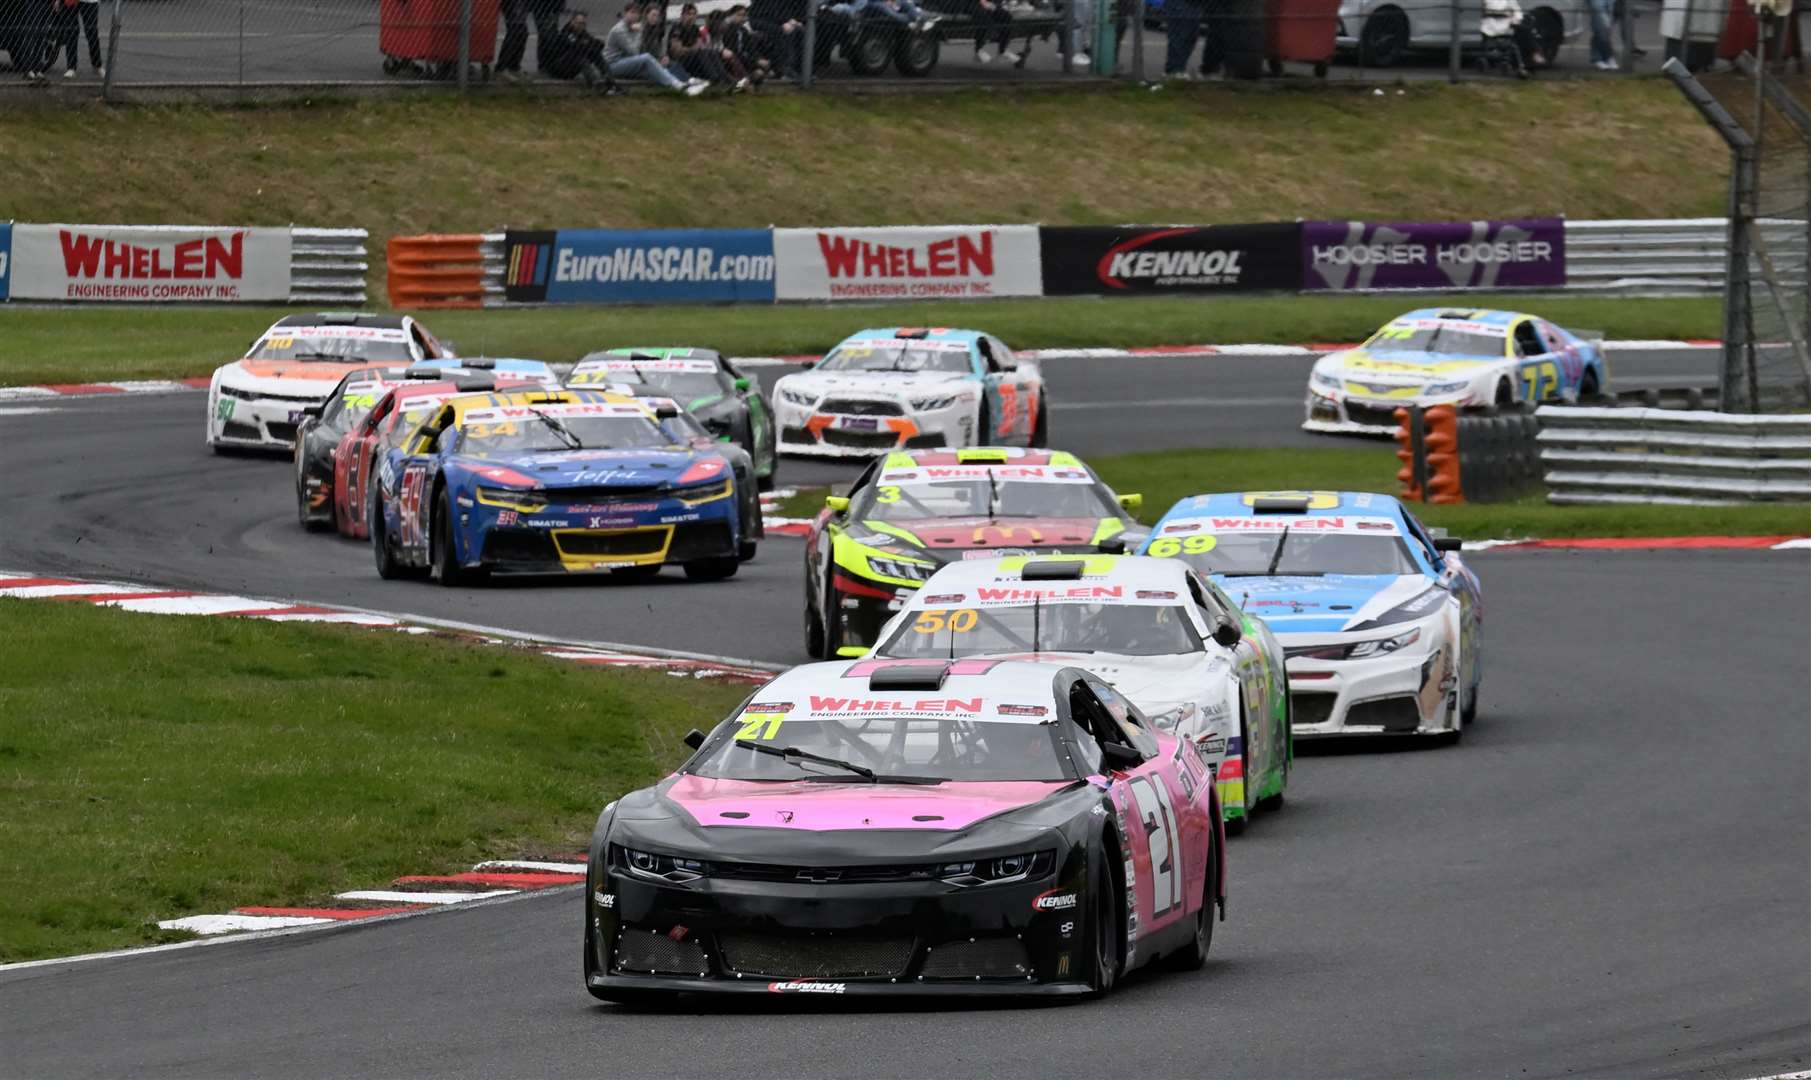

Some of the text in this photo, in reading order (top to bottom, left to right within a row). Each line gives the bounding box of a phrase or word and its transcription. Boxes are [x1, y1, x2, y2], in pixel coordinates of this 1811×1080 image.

[59, 230, 244, 279] WHELEN
[817, 231, 994, 278] WHELEN
[1109, 250, 1242, 277] KENNOL
[1312, 241, 1552, 265] HOOSIER HOOSIER
[555, 247, 774, 282] EuroNASCAR.com
[67, 284, 240, 298] ENGINEERING COMPANY INC.
[830, 283, 908, 296] ENGINEERING
[910, 283, 967, 295] COMPANY
[1522, 362, 1559, 401] 72
[342, 394, 376, 410] 74
[466, 422, 519, 438] 34
[876, 486, 901, 504] 3
[1211, 517, 1344, 529] WHELEN
[1147, 534, 1217, 558] 69
[977, 585, 1122, 600] WHELEN
[912, 609, 978, 633] 50
[809, 696, 983, 713] WHELEN
[734, 713, 785, 741] 21
[1129, 771, 1182, 920] 21
[1036, 893, 1077, 907] KENNOL
[774, 982, 847, 991] KENNOL
